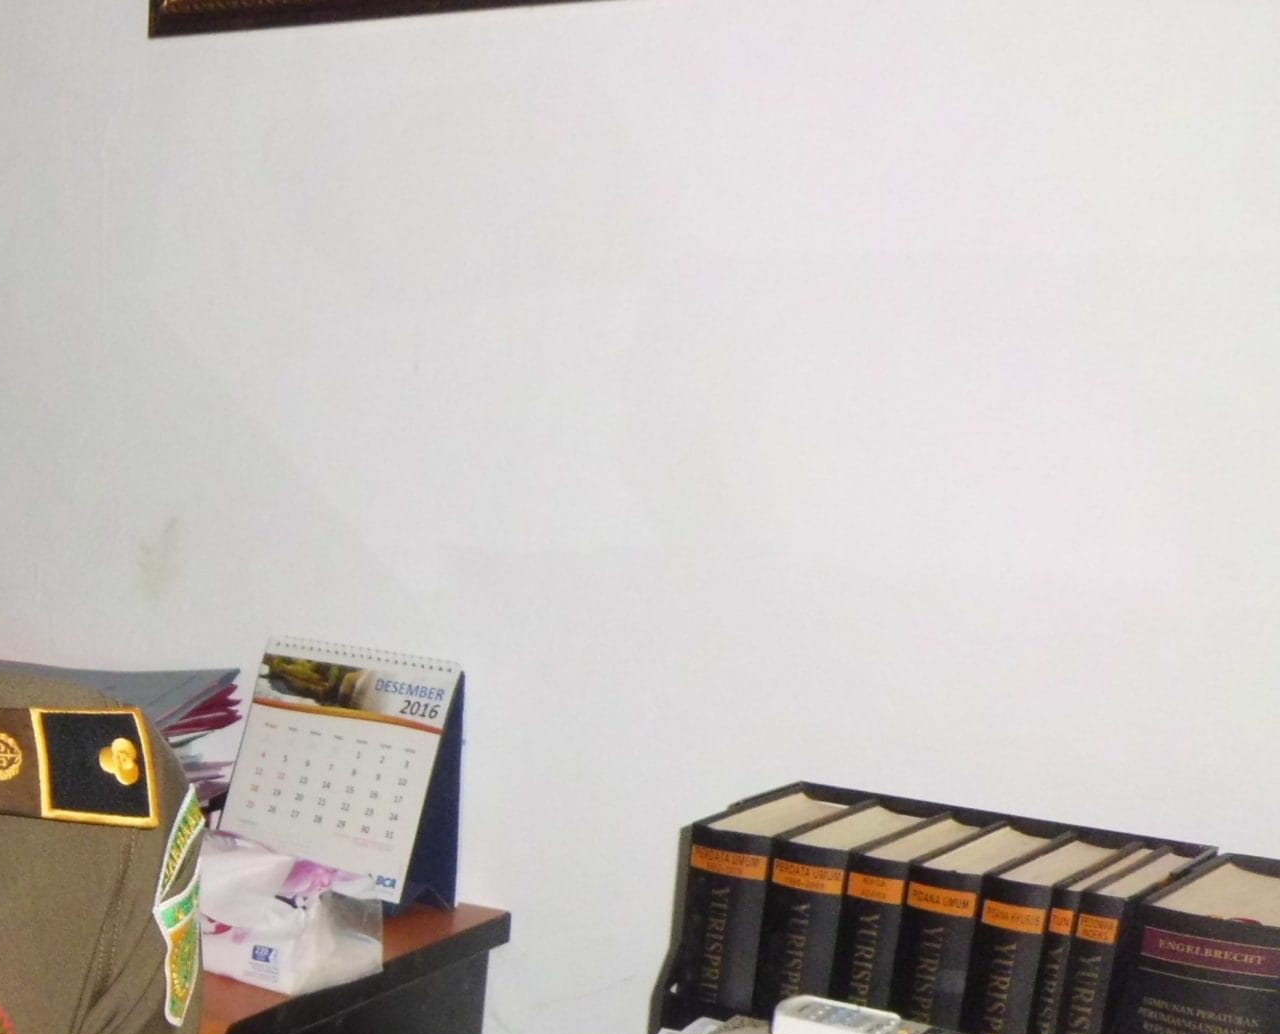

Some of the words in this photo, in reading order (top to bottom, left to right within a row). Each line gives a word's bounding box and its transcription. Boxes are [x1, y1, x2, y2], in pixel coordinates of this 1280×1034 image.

[374, 678, 445, 701] DESEMBER
[400, 700, 441, 719] 2016
[1158, 938, 1267, 967] ENGELBRECHT
